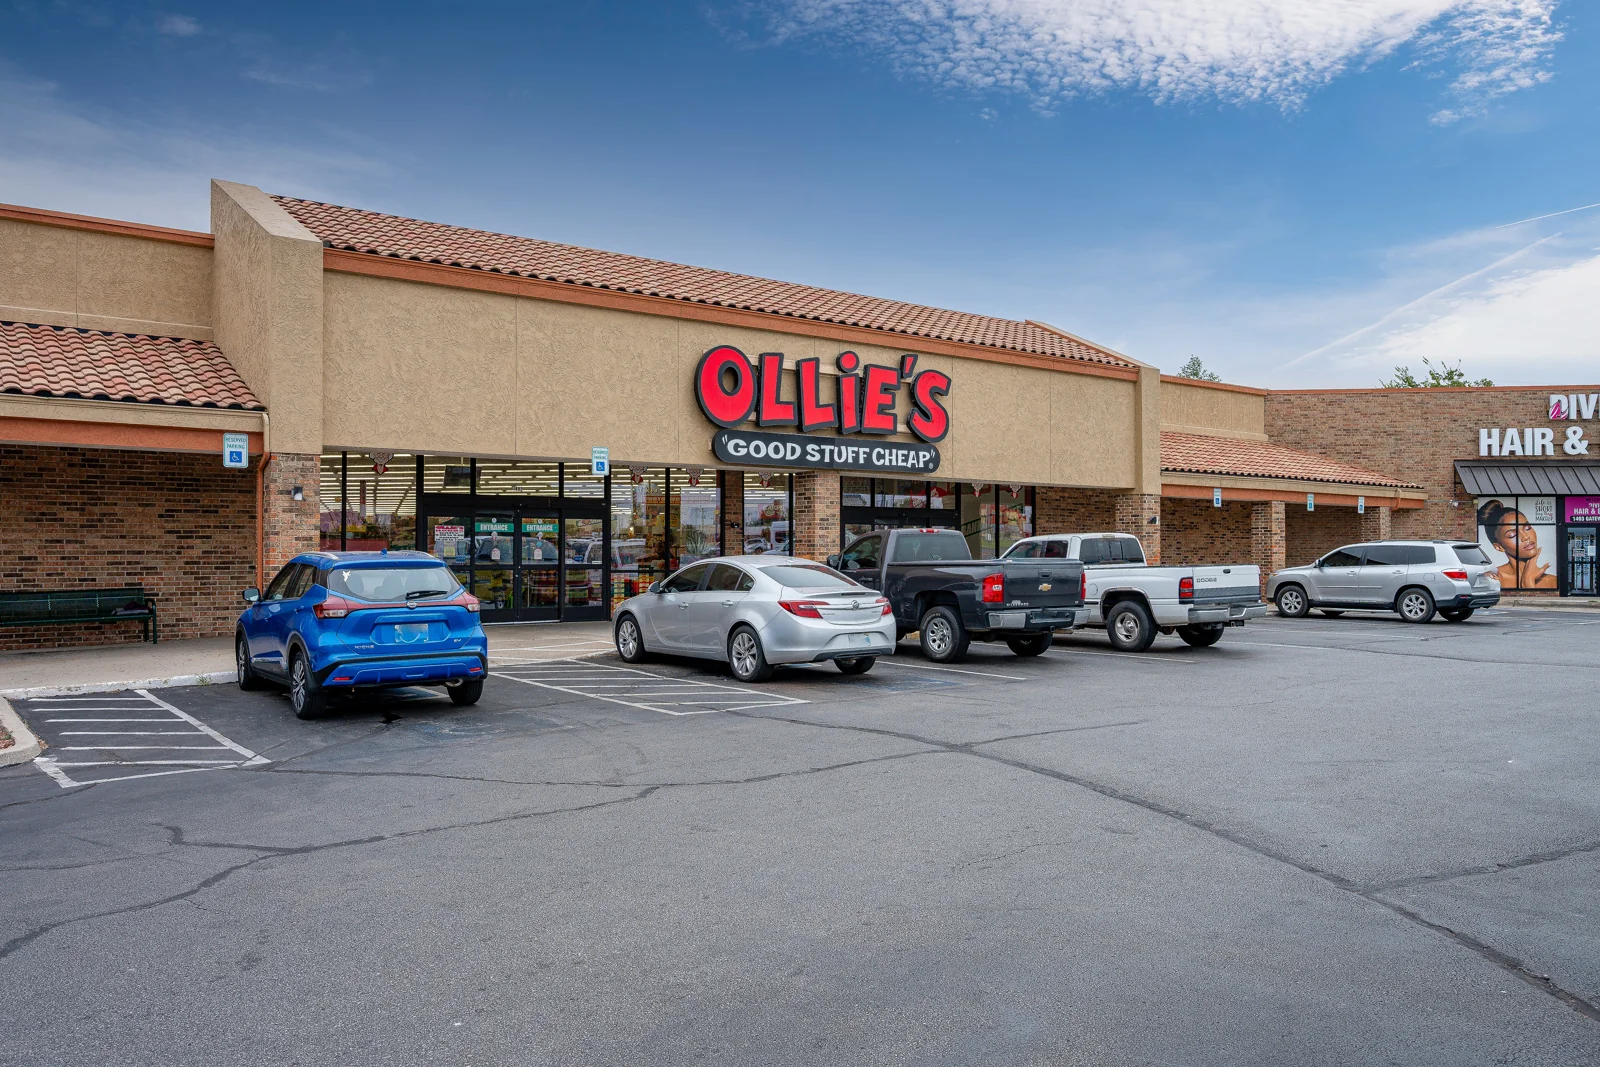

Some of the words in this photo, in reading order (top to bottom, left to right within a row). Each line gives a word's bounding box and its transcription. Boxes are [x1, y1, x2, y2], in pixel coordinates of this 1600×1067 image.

[694, 345, 952, 443] OLLiE'S
[1549, 394, 1600, 420] DIV
[805, 444, 869, 464] STUFF
[1478, 427, 1554, 456] HAIR
[1563, 426, 1589, 456] &
